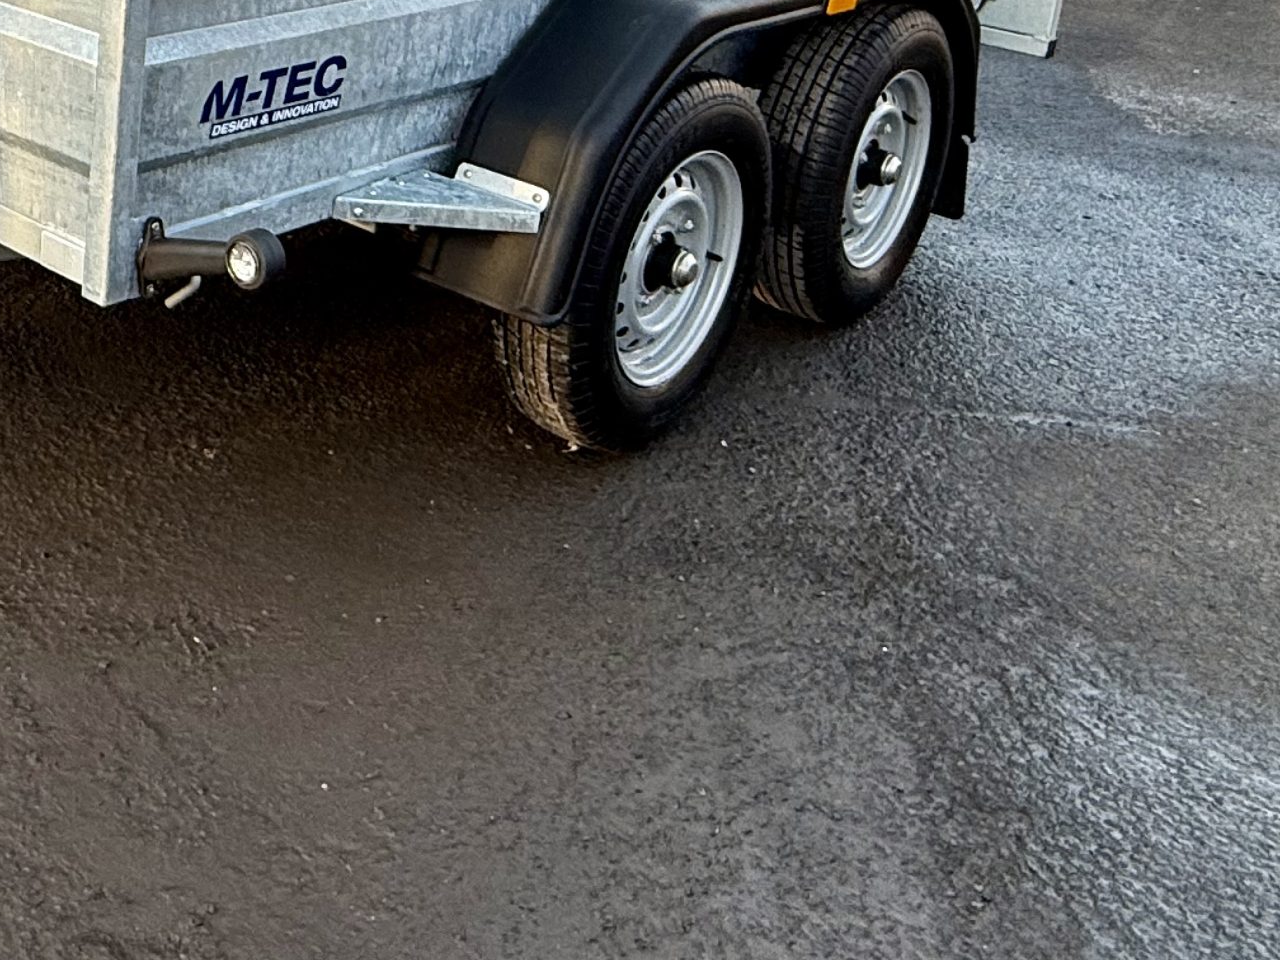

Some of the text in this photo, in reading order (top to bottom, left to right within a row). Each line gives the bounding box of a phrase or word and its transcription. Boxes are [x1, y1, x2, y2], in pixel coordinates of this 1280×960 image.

[199, 54, 348, 124] M-TEC
[210, 96, 341, 137] DESIGN & INNOVATION
